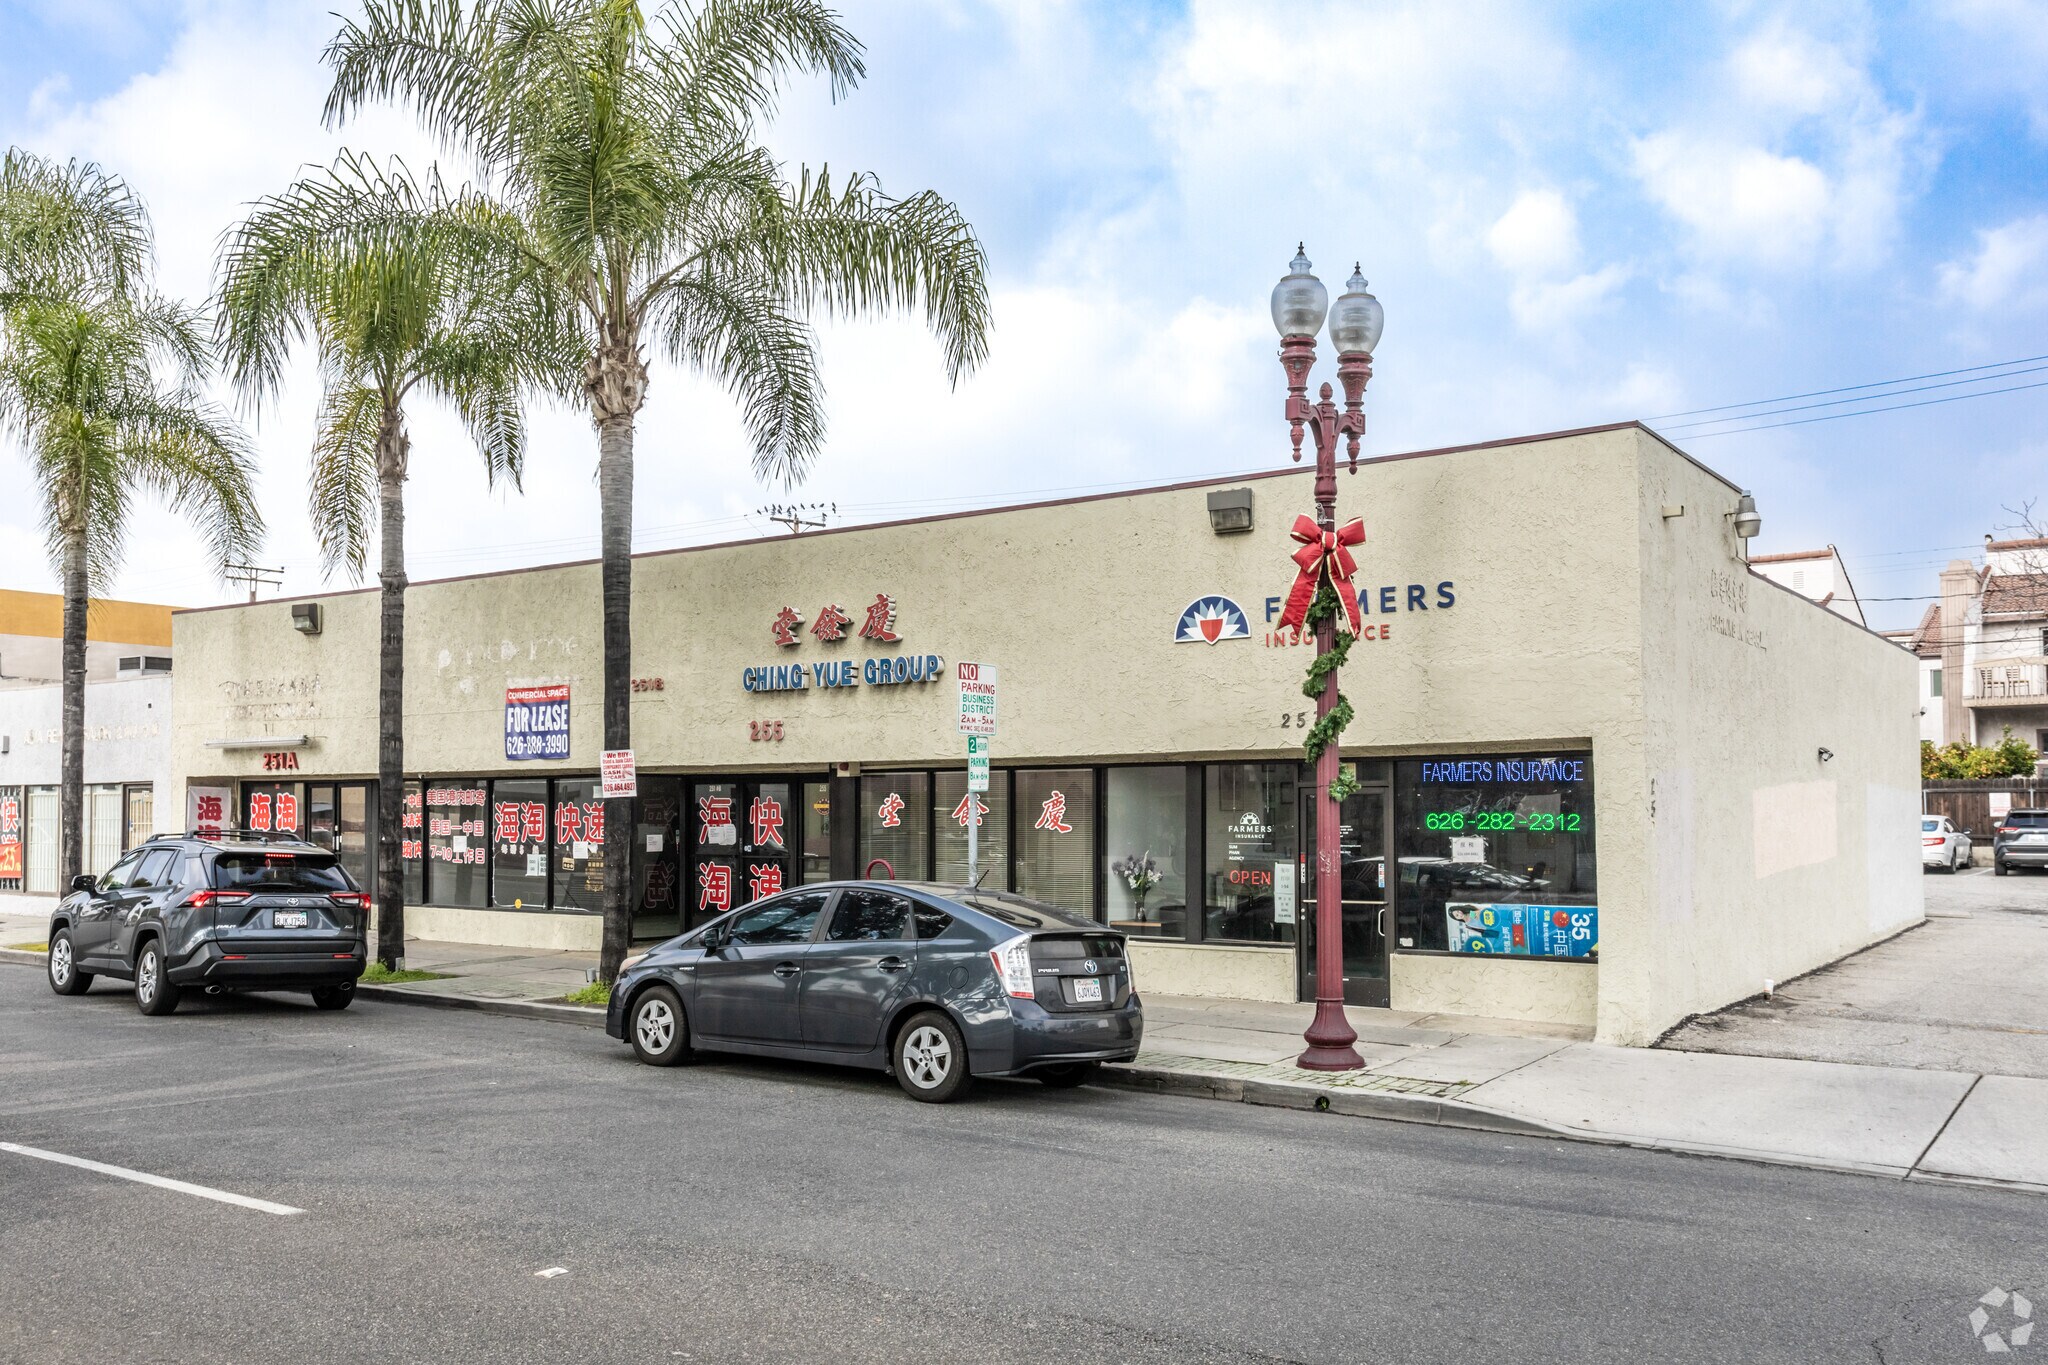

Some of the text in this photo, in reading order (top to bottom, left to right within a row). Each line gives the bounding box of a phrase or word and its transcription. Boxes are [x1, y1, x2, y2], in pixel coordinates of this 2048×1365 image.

[1265, 581, 1455, 622] FMERS
[1265, 624, 1391, 648] INSUCE
[743, 655, 943, 692] CHING YUE GROUP
[960, 664, 977, 680] NO
[507, 688, 568, 700] COMMERCIAL SPACE
[961, 682, 995, 695] PARKING
[962, 694, 995, 705] BUSINESS
[962, 704, 994, 714] DISTRICT
[507, 704, 569, 733] FOR LEASE
[1281, 711, 1318, 729] 25
[749, 720, 785, 741] 255
[506, 734, 568, 755] 626-888-3990
[970, 739, 976, 751] 2
[263, 752, 299, 771] 251A
[970, 758, 988, 768] PARKING
[1423, 760, 1584, 782] FARMERS INSURANCE
[250, 792, 298, 832] 海淘
[1426, 812, 1581, 831] 626-282-2312
[495, 801, 547, 843] 海淘
[1228, 825, 1272, 833] FARMERS
[1229, 869, 1271, 886] OPEN
